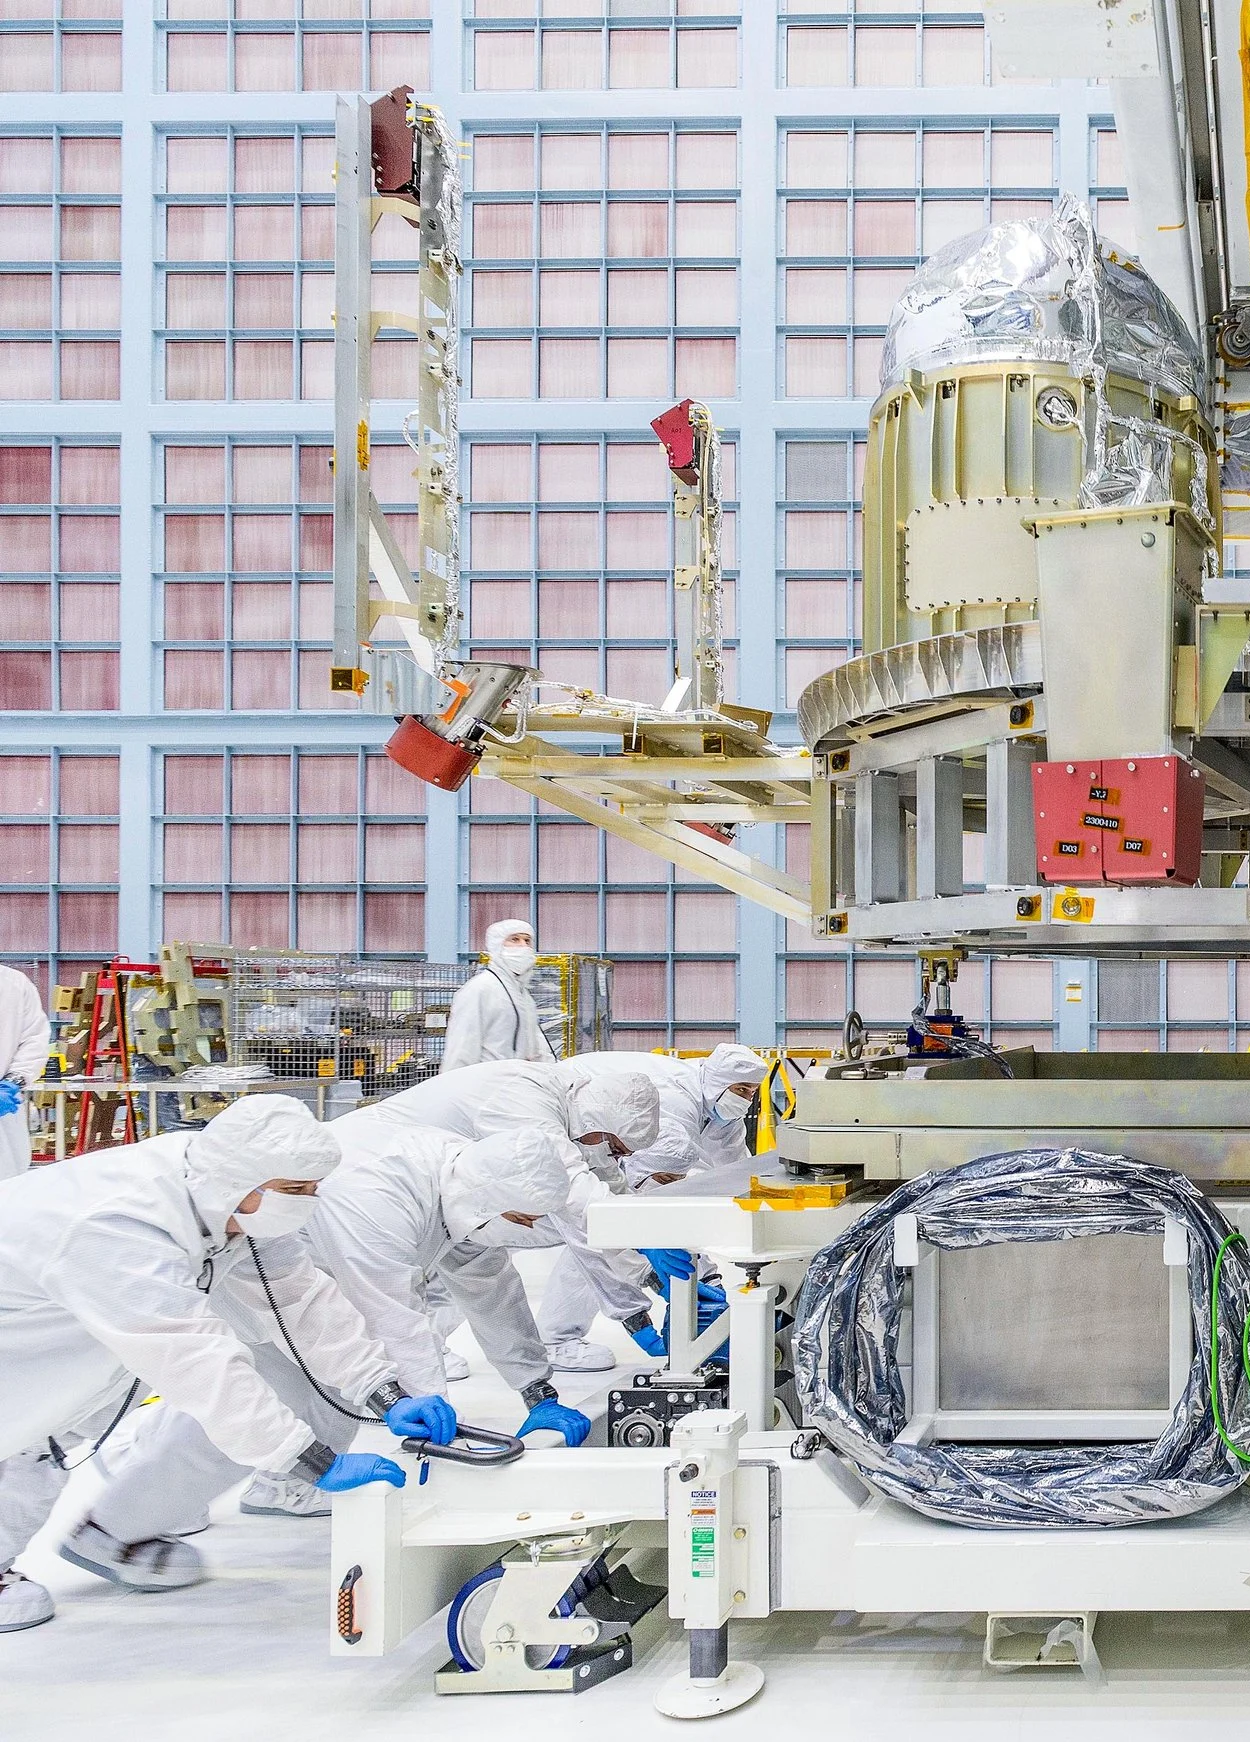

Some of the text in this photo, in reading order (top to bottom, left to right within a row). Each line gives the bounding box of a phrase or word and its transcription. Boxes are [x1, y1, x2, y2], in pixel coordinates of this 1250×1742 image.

[1085, 816, 1118, 828] 2300410
[1061, 844, 1077, 853] D03
[1125, 842, 1142, 850] D07
